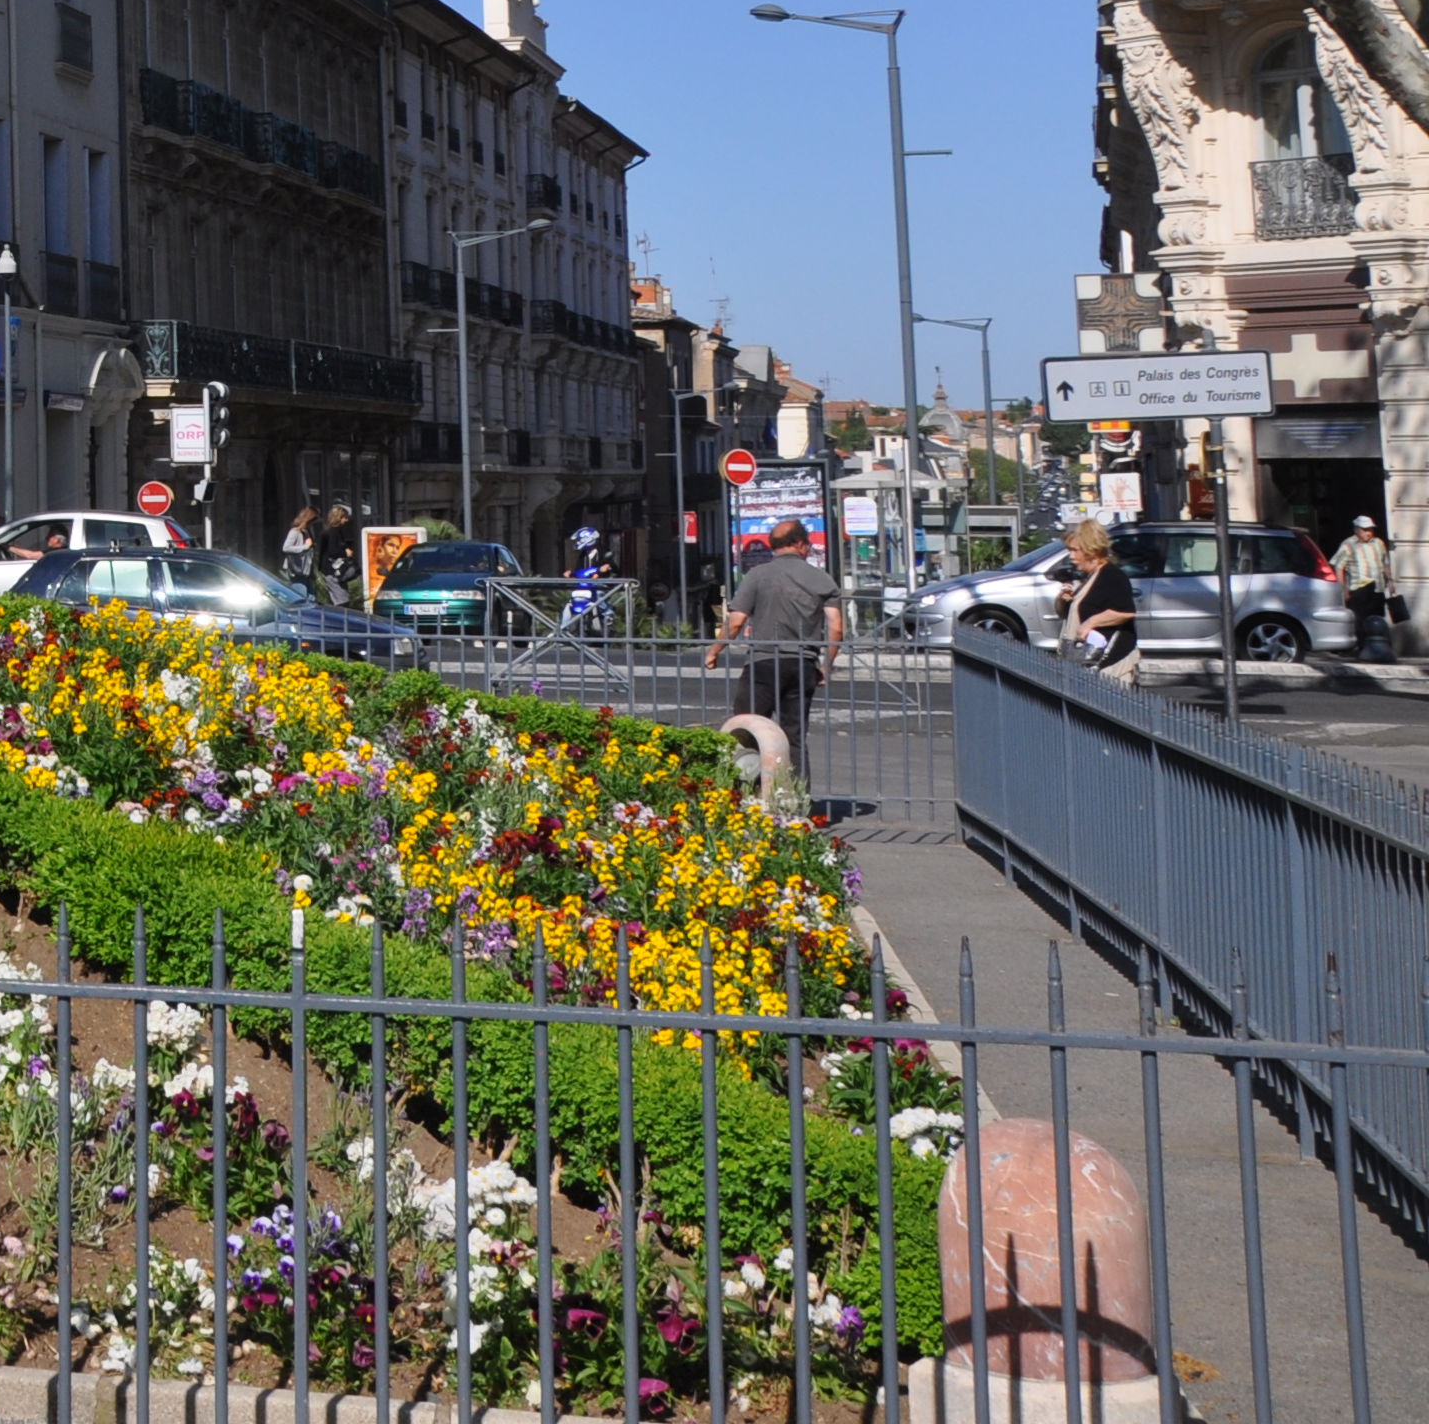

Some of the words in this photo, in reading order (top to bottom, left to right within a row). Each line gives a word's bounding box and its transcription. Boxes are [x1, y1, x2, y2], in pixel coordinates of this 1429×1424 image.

[1137, 368, 1173, 382] Palais
[1179, 367, 1201, 381] des
[1206, 365, 1259, 382] Congrès
[1139, 391, 1175, 405] Office
[1182, 391, 1198, 404] du
[1206, 388, 1261, 402] Tourisme
